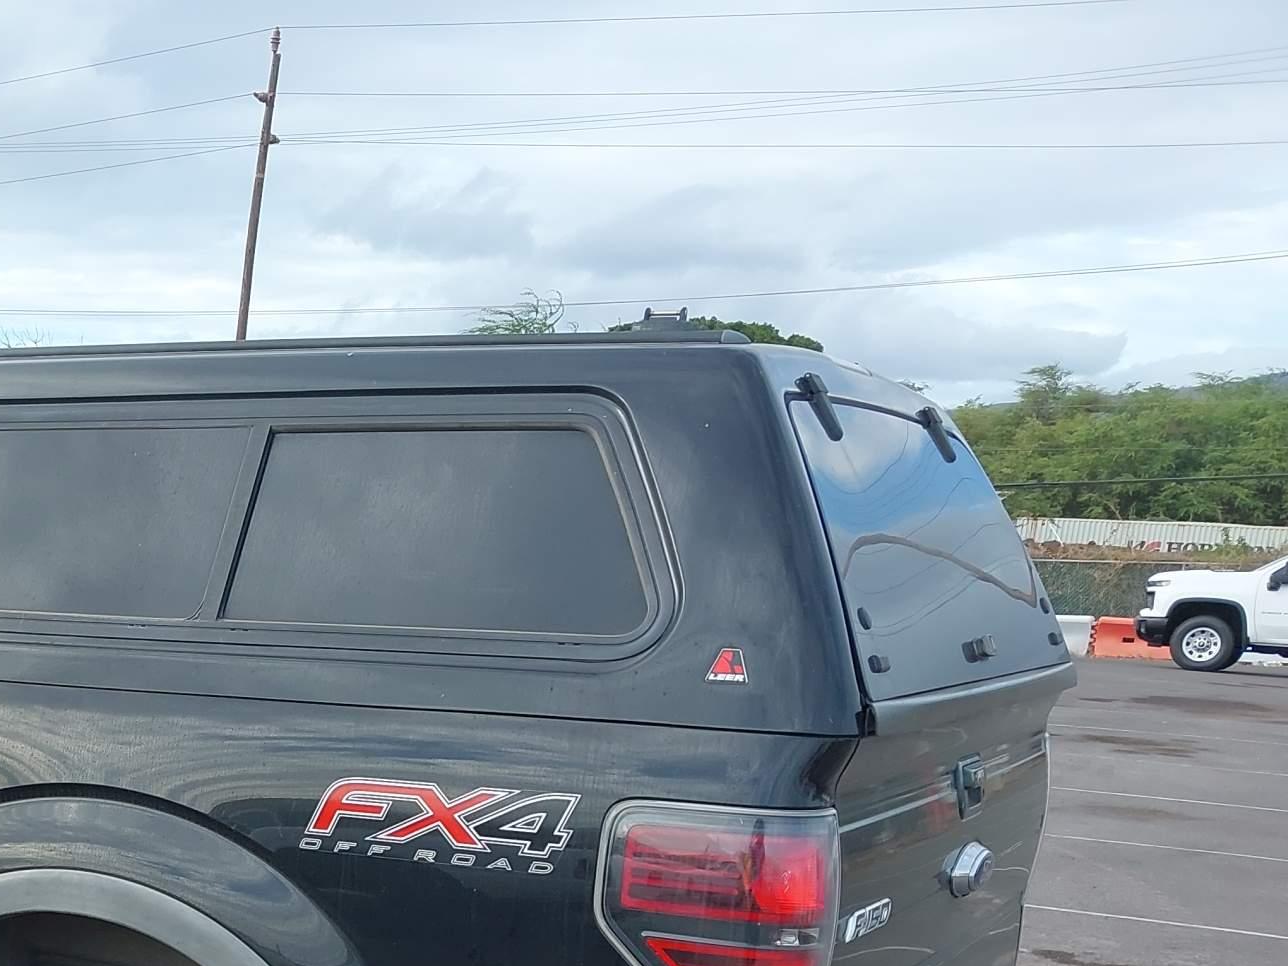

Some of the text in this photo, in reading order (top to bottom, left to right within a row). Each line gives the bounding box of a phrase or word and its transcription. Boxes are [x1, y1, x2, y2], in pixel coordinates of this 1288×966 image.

[708, 673, 745, 682] LEER
[304, 777, 582, 858] FX4
[299, 837, 554, 875] OFF ROAD
